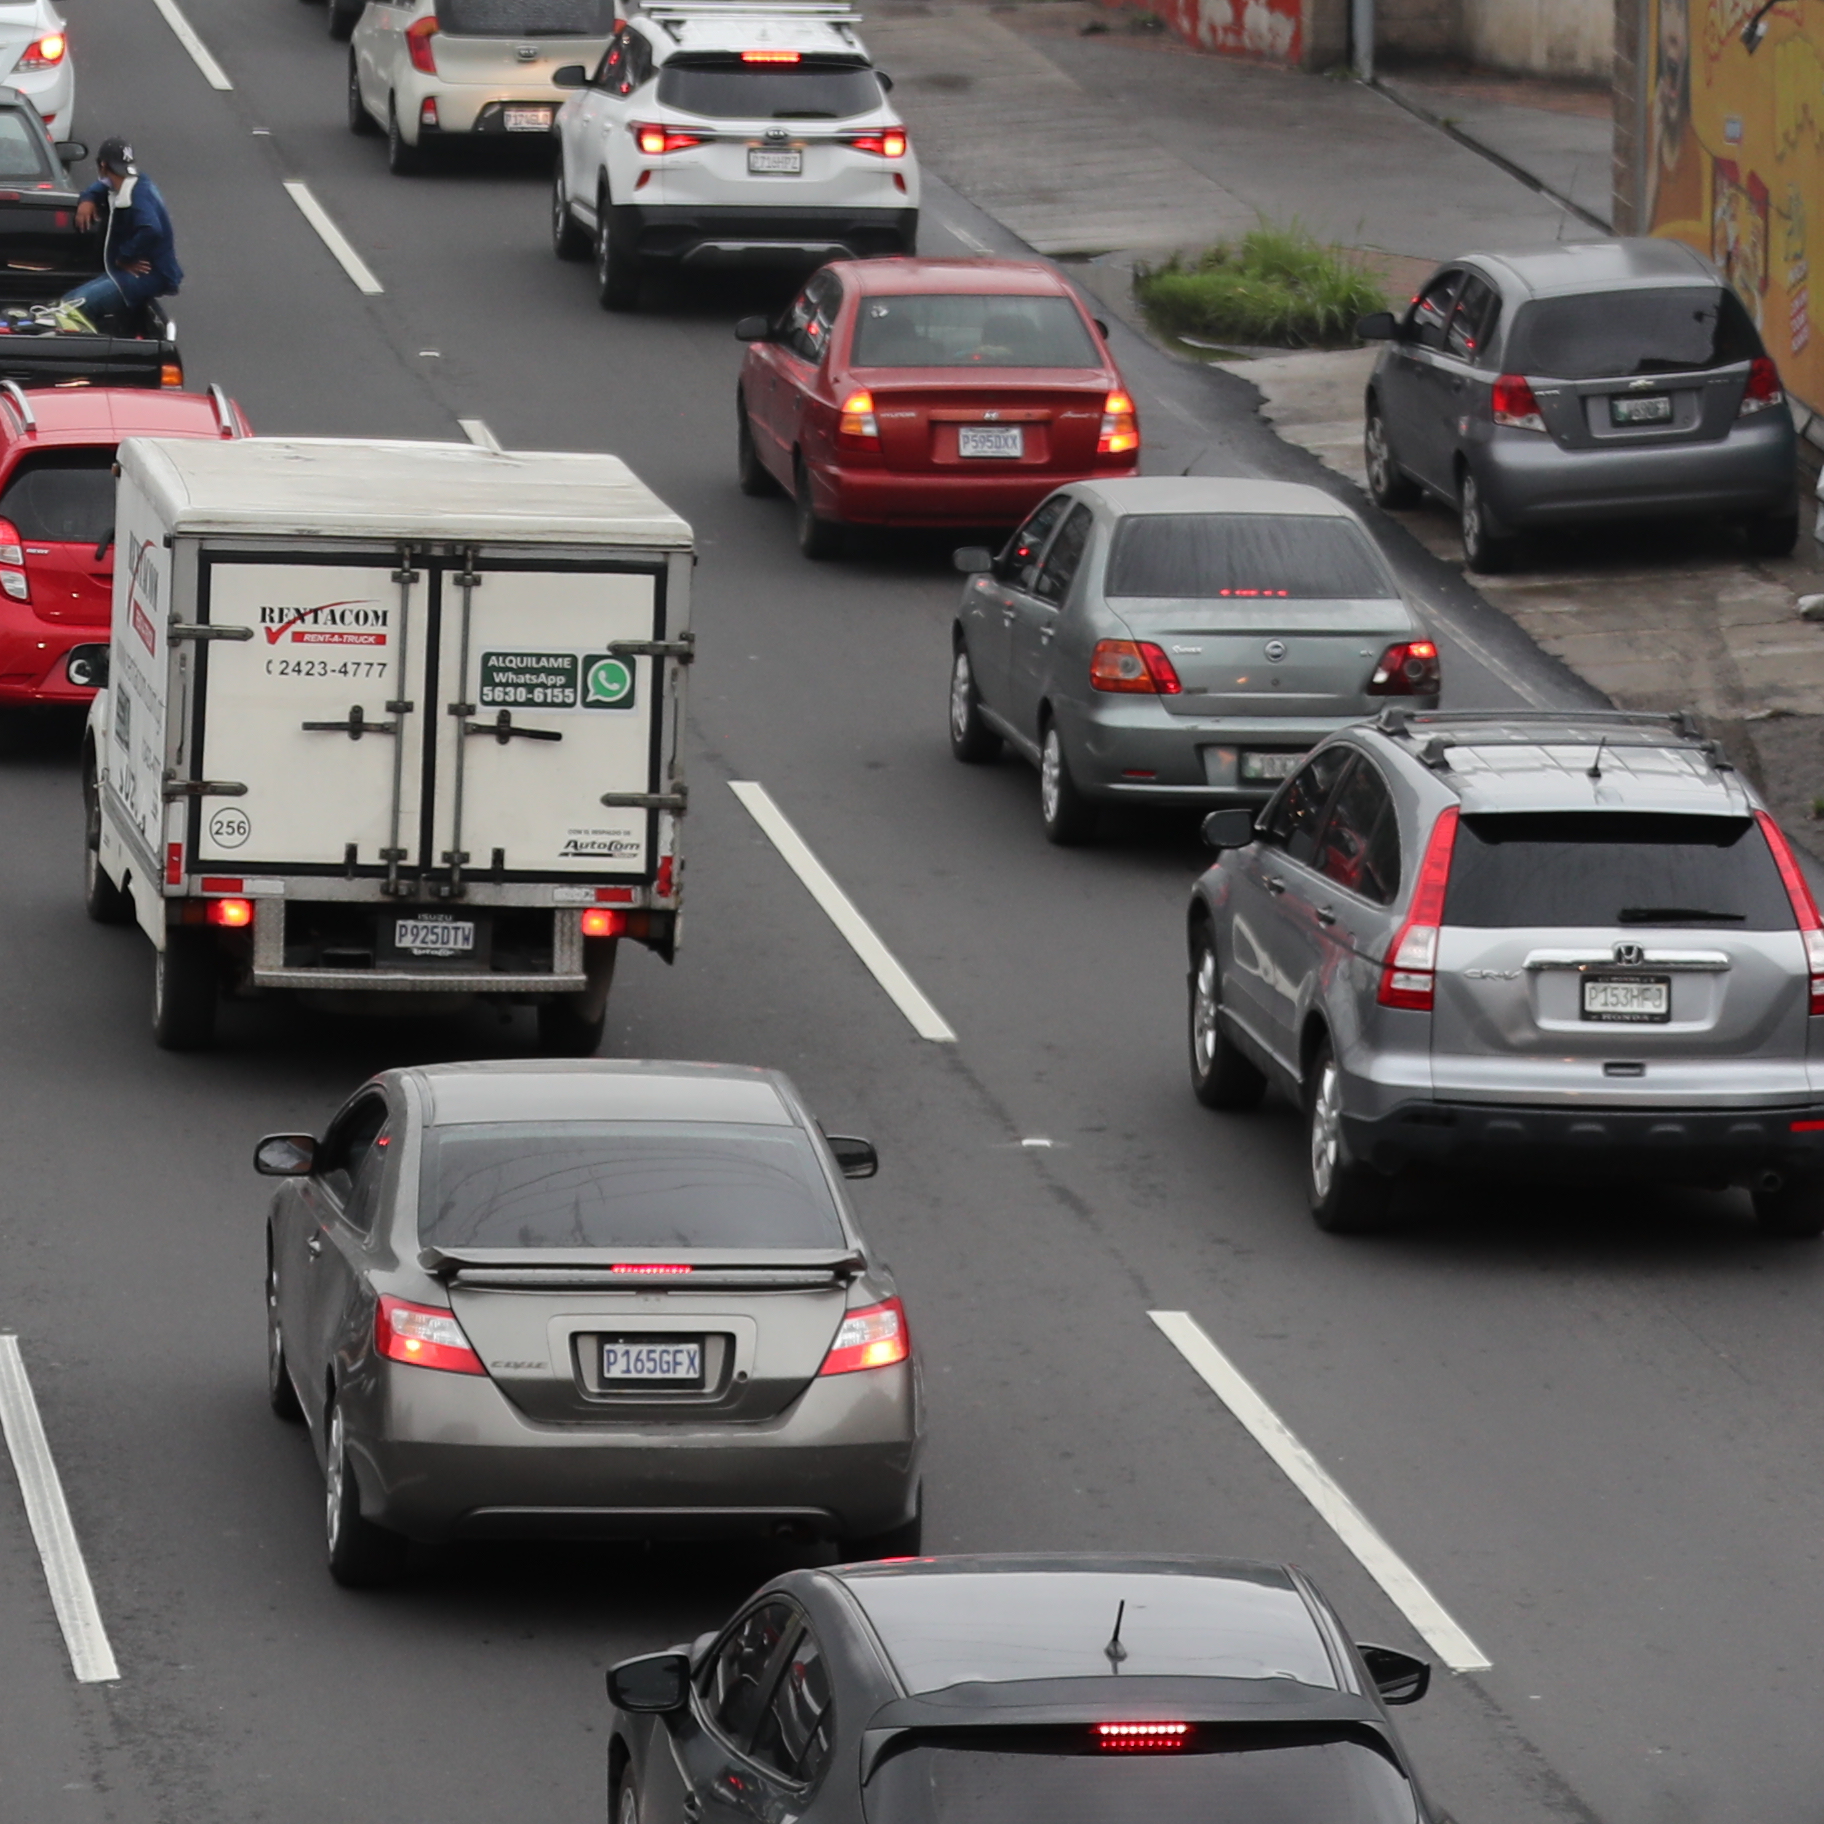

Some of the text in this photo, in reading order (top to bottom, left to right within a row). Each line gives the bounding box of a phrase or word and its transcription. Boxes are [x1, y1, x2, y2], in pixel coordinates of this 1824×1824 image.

[260, 606, 389, 628] RENTACOM
[303, 633, 376, 644] RENT-A-TRUCK
[279, 659, 388, 678] 2423-4777
[487, 655, 573, 670] ALQUILAME
[493, 671, 566, 687] WhatsApp
[482, 686, 575, 704] 5630-6155
[213, 820, 247, 836] 256
[398, 924, 472, 947] P925DTW
[605, 1349, 698, 1375] P165GFX
